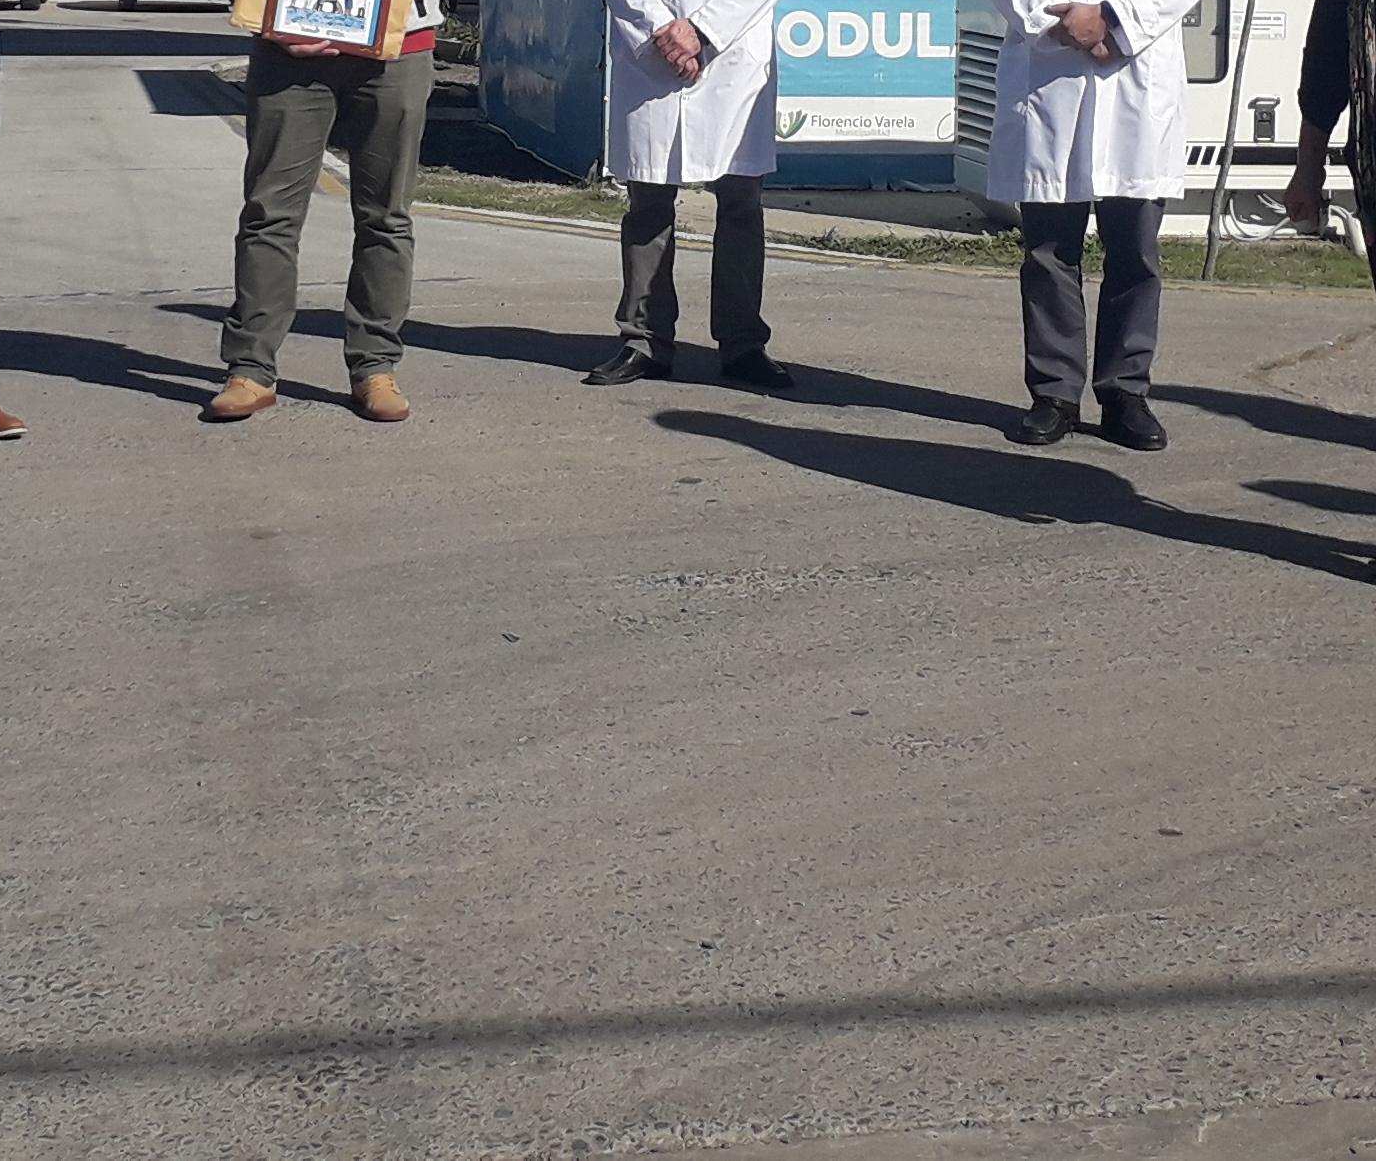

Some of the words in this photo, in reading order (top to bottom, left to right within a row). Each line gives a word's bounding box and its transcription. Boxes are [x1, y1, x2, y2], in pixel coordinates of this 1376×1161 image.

[777, 10, 956, 58] ODUL
[811, 114, 872, 128] Florencio
[875, 115, 915, 128] Varela
